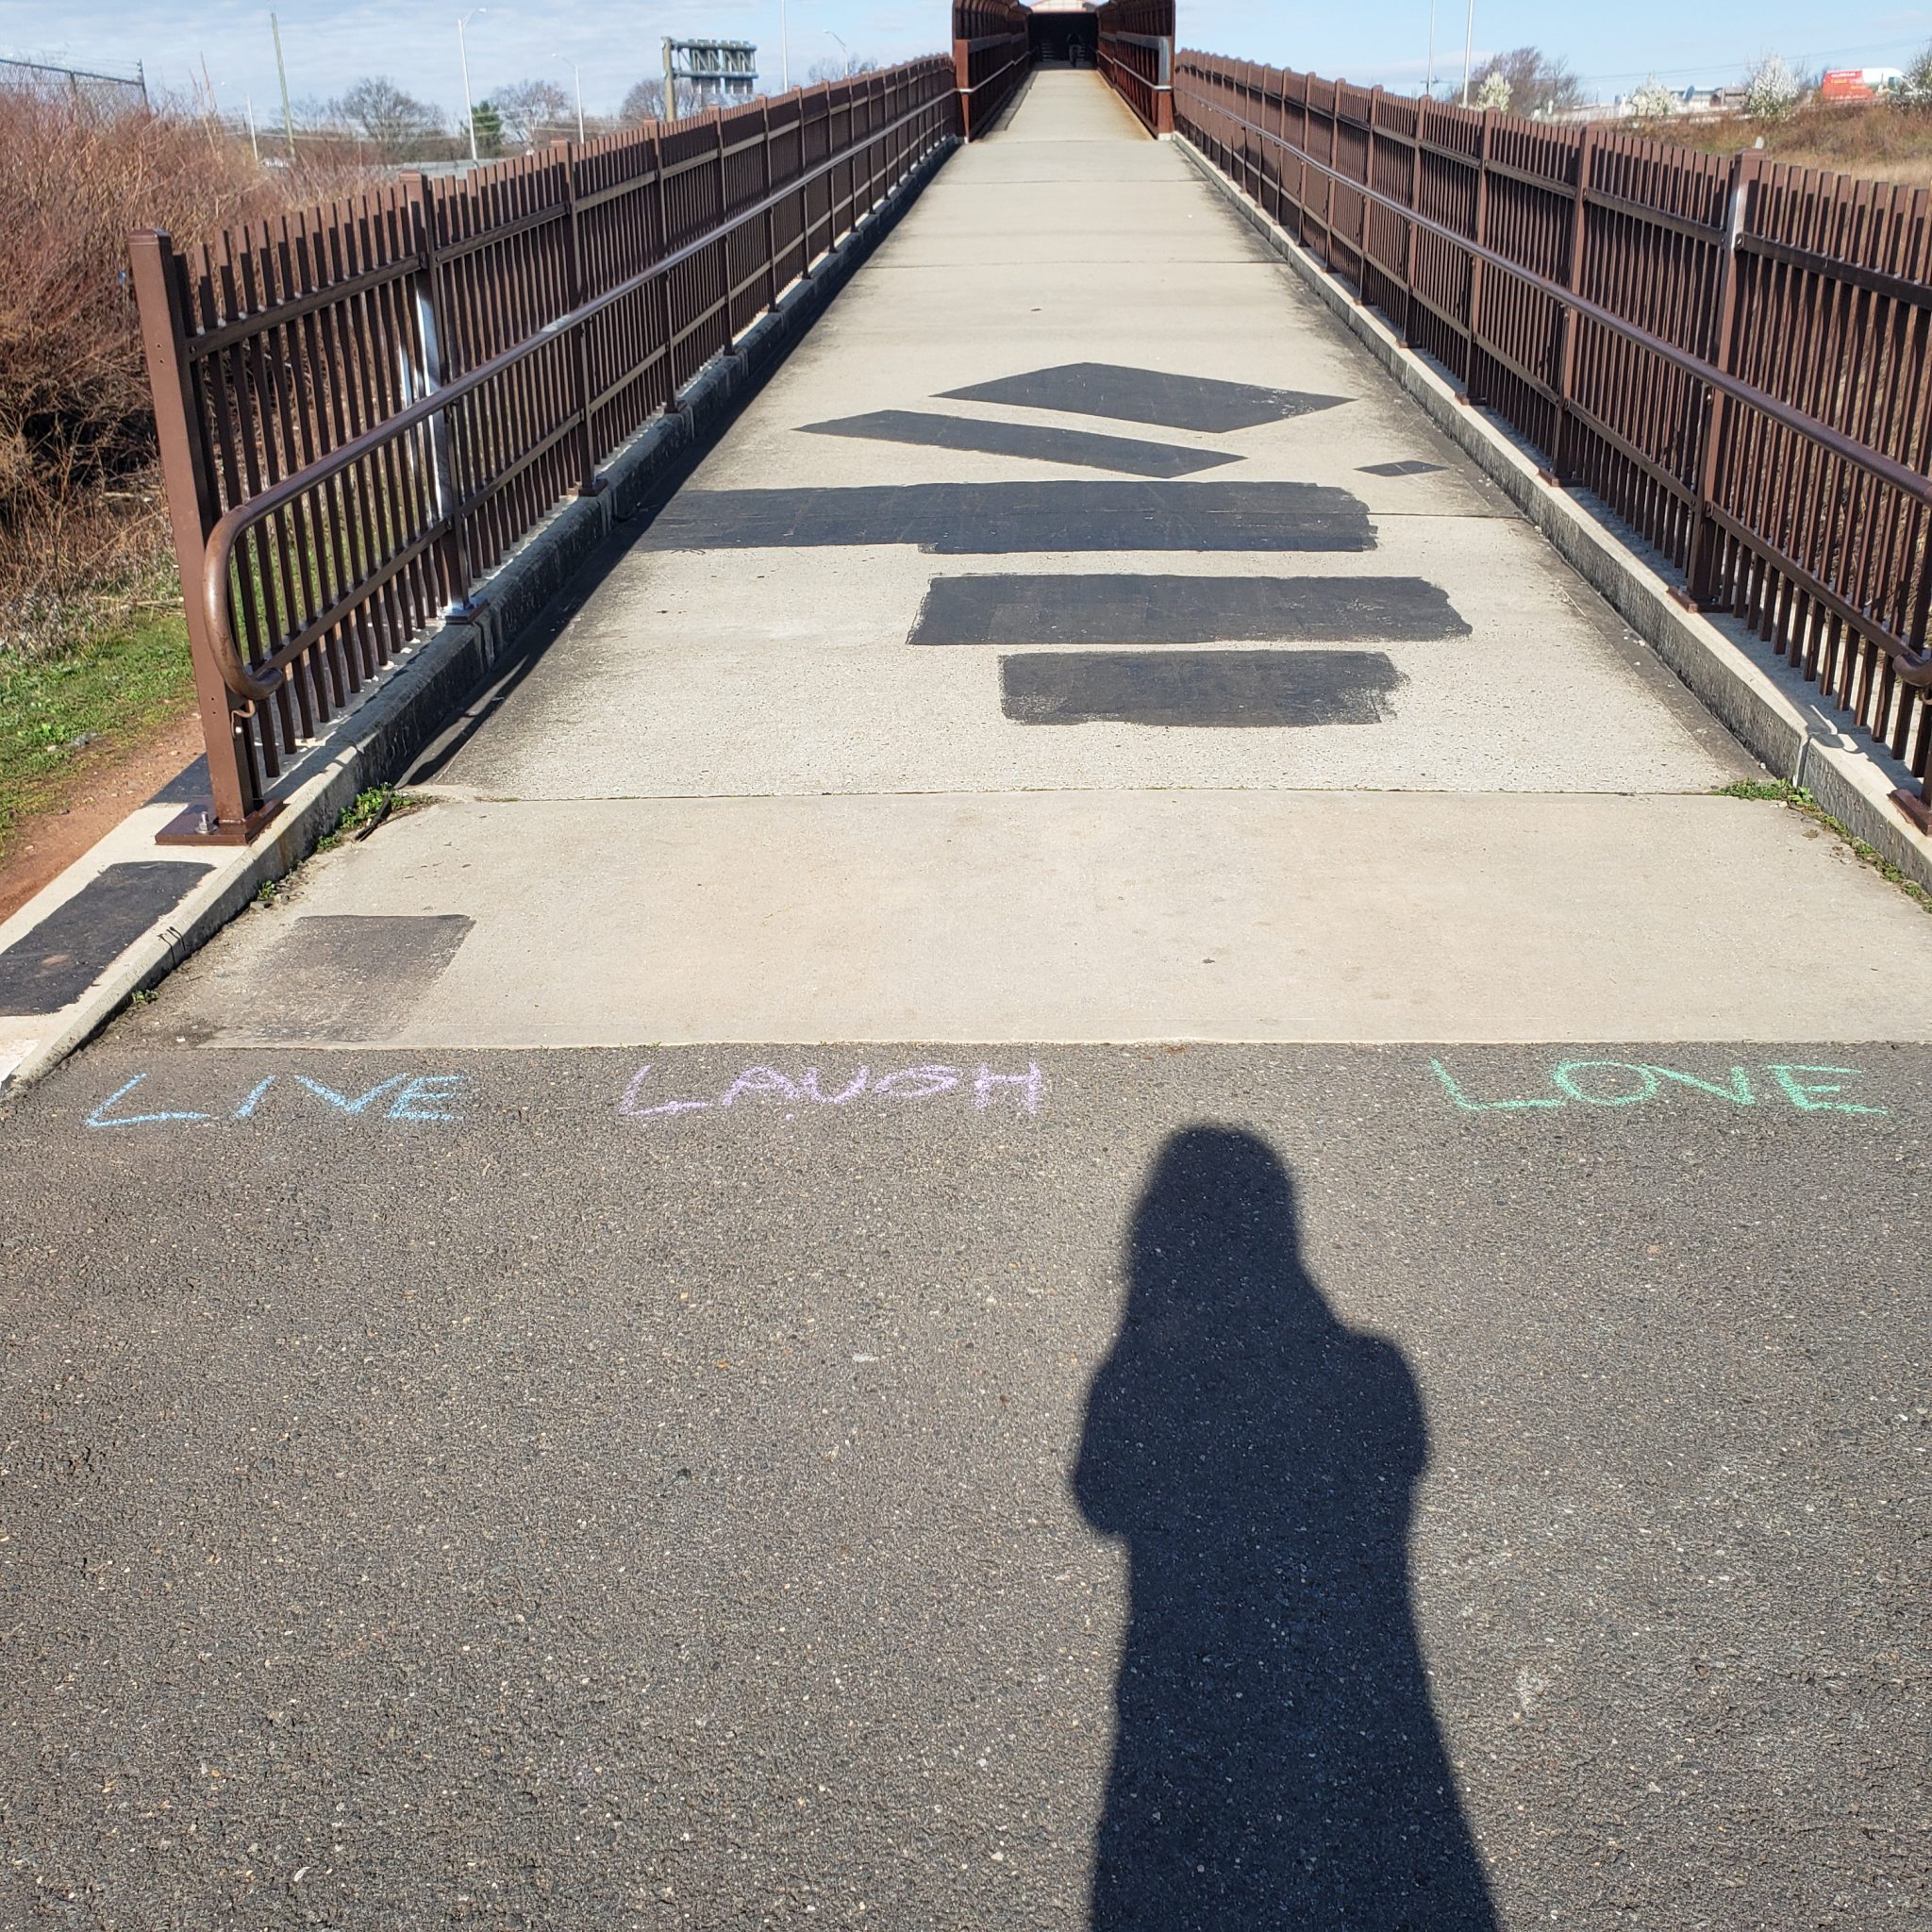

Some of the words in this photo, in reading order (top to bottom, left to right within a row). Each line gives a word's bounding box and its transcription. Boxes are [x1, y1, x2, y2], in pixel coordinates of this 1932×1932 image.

[85, 1072, 469, 1127] LIVE
[618, 1062, 1045, 1119] LAUGH
[1428, 1058, 1889, 1115] LOVE
